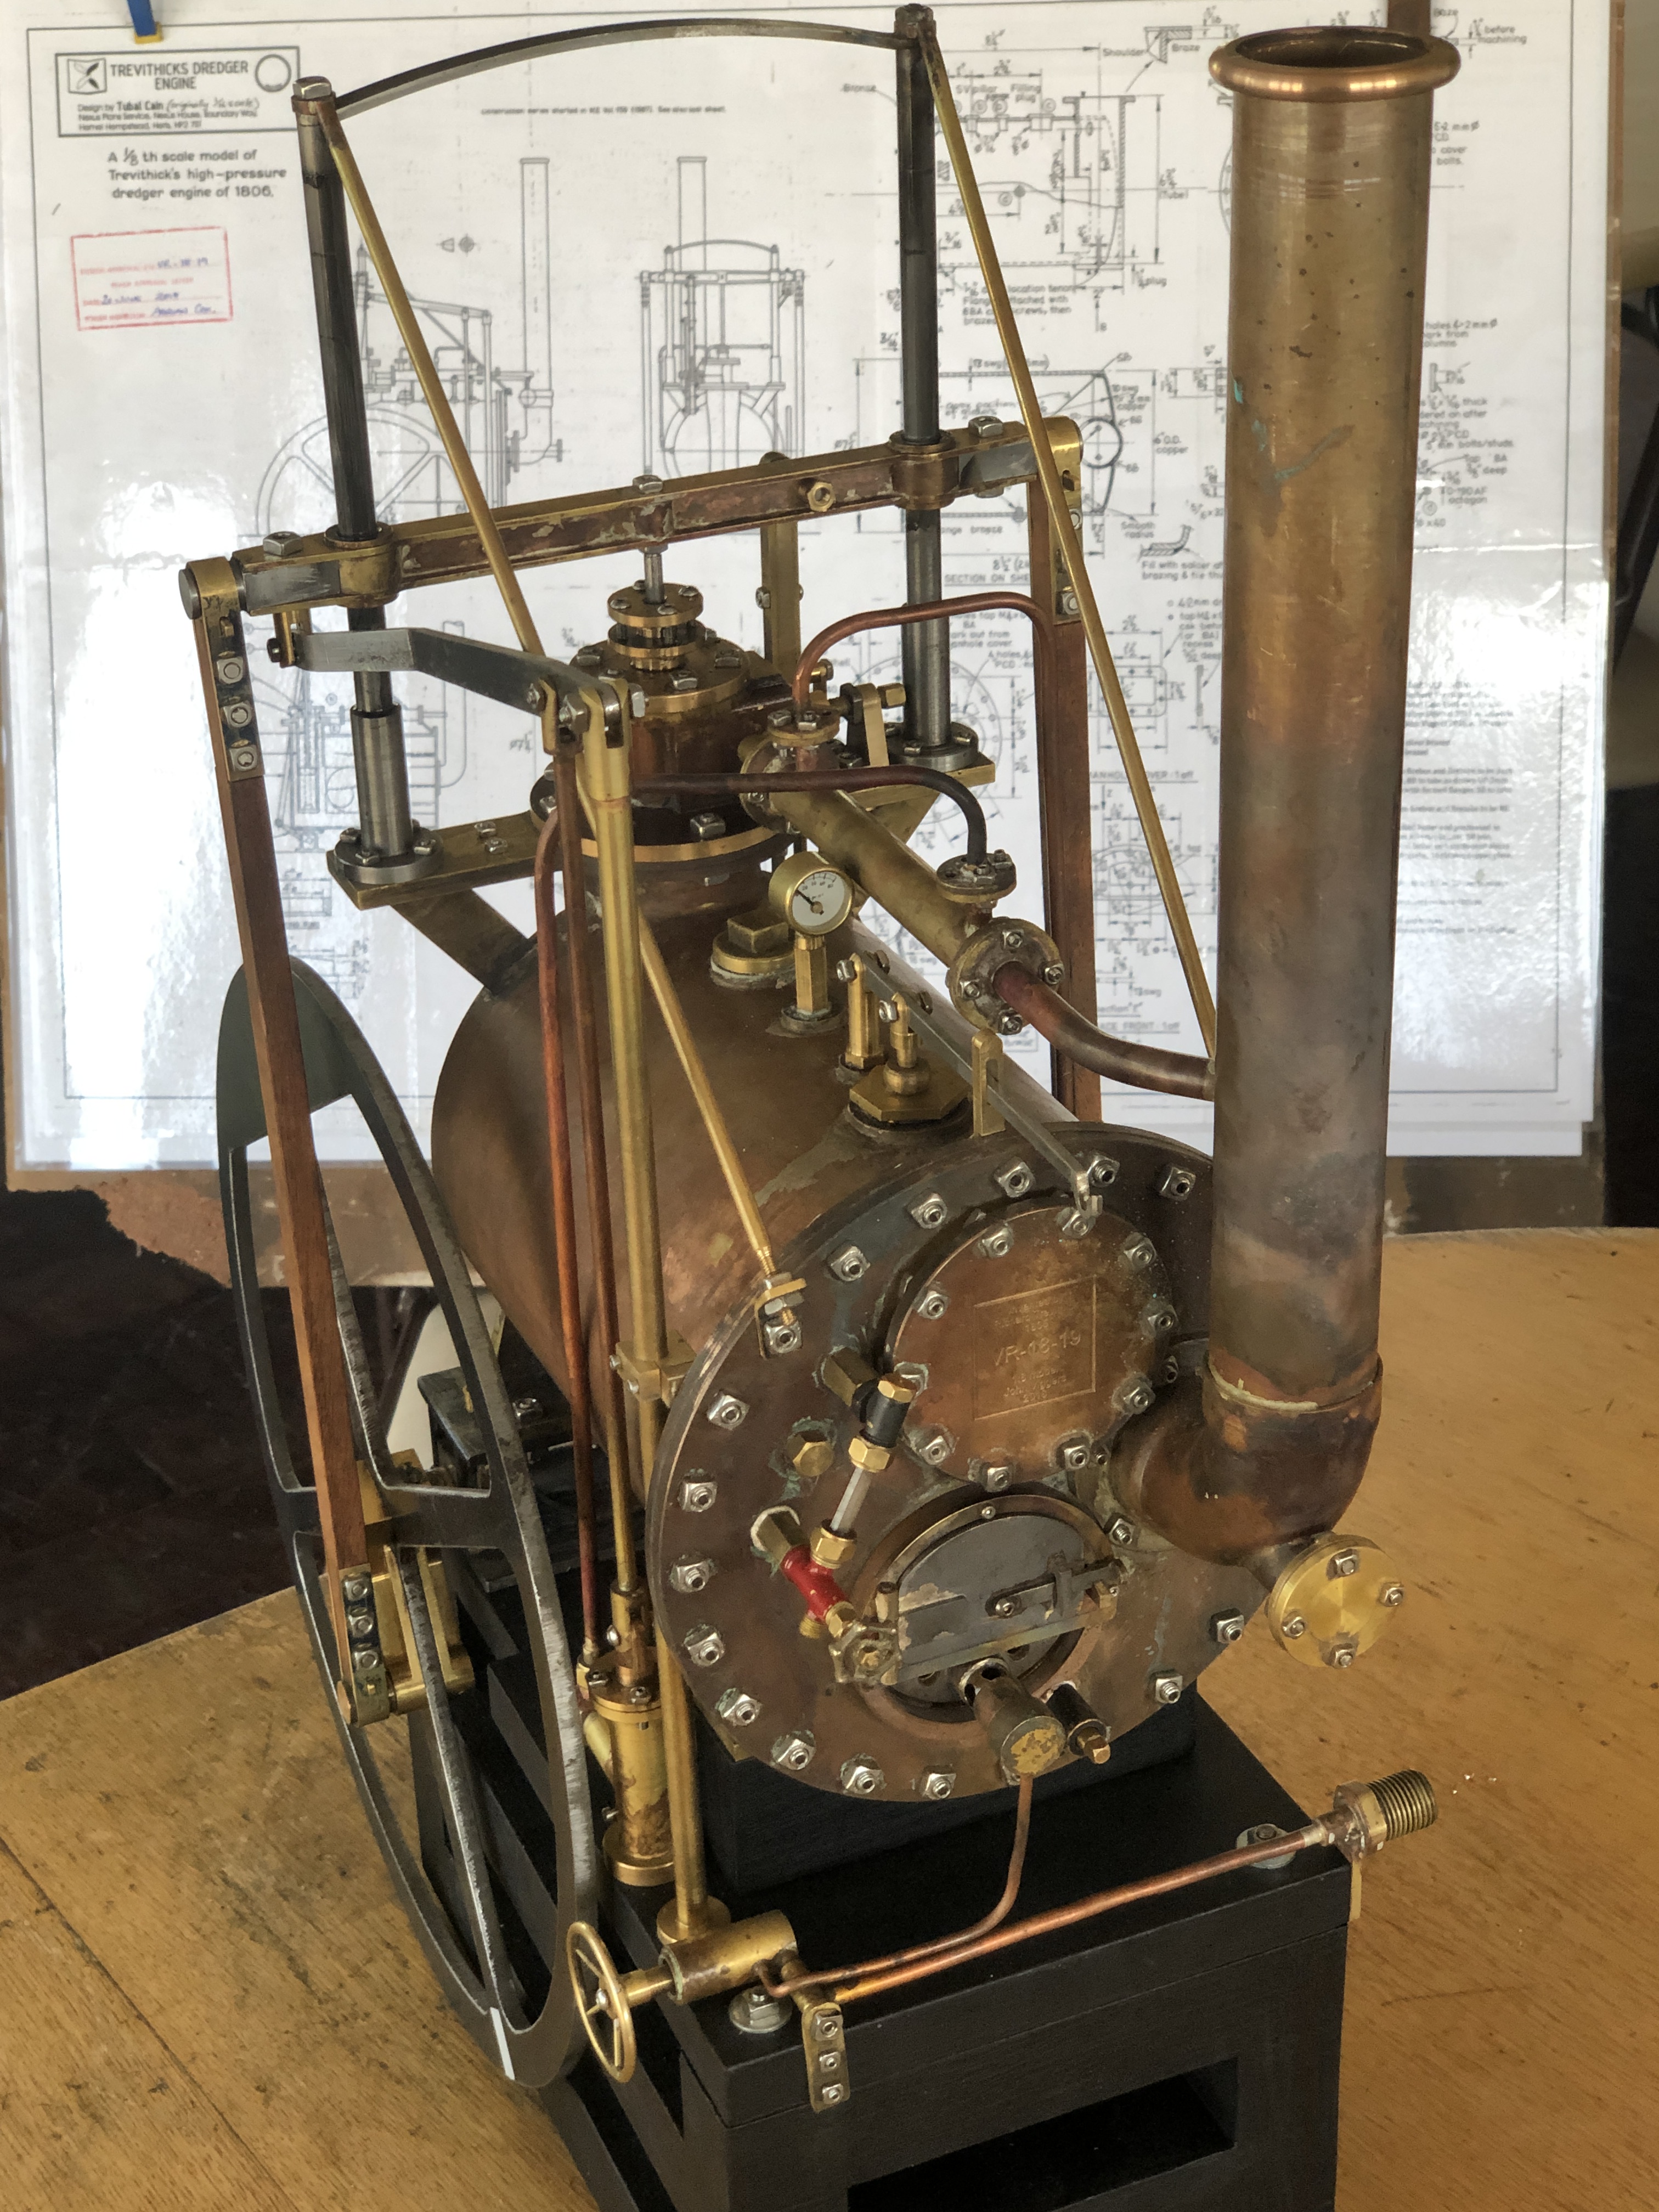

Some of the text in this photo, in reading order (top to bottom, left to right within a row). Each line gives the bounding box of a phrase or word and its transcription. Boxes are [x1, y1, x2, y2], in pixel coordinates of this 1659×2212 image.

[110, 60, 249, 77] TREVITHICKS DREDGER
[154, 76, 197, 90] ENGINE
[116, 100, 142, 111] Tubal
[145, 100, 164, 110] Cain
[108, 151, 118, 162] A
[143, 151, 158, 162] th
[162, 150, 195, 162] scale
[199, 149, 239, 161] model
[242, 149, 258, 161] of
[108, 167, 287, 182] Trevithick's high-pressure
[112, 185, 274, 201] dredger engine of 1806.
[963, 296, 991, 307] Flang
[944, 573, 986, 583] SECTION
[951, 640, 984, 649] anhole
